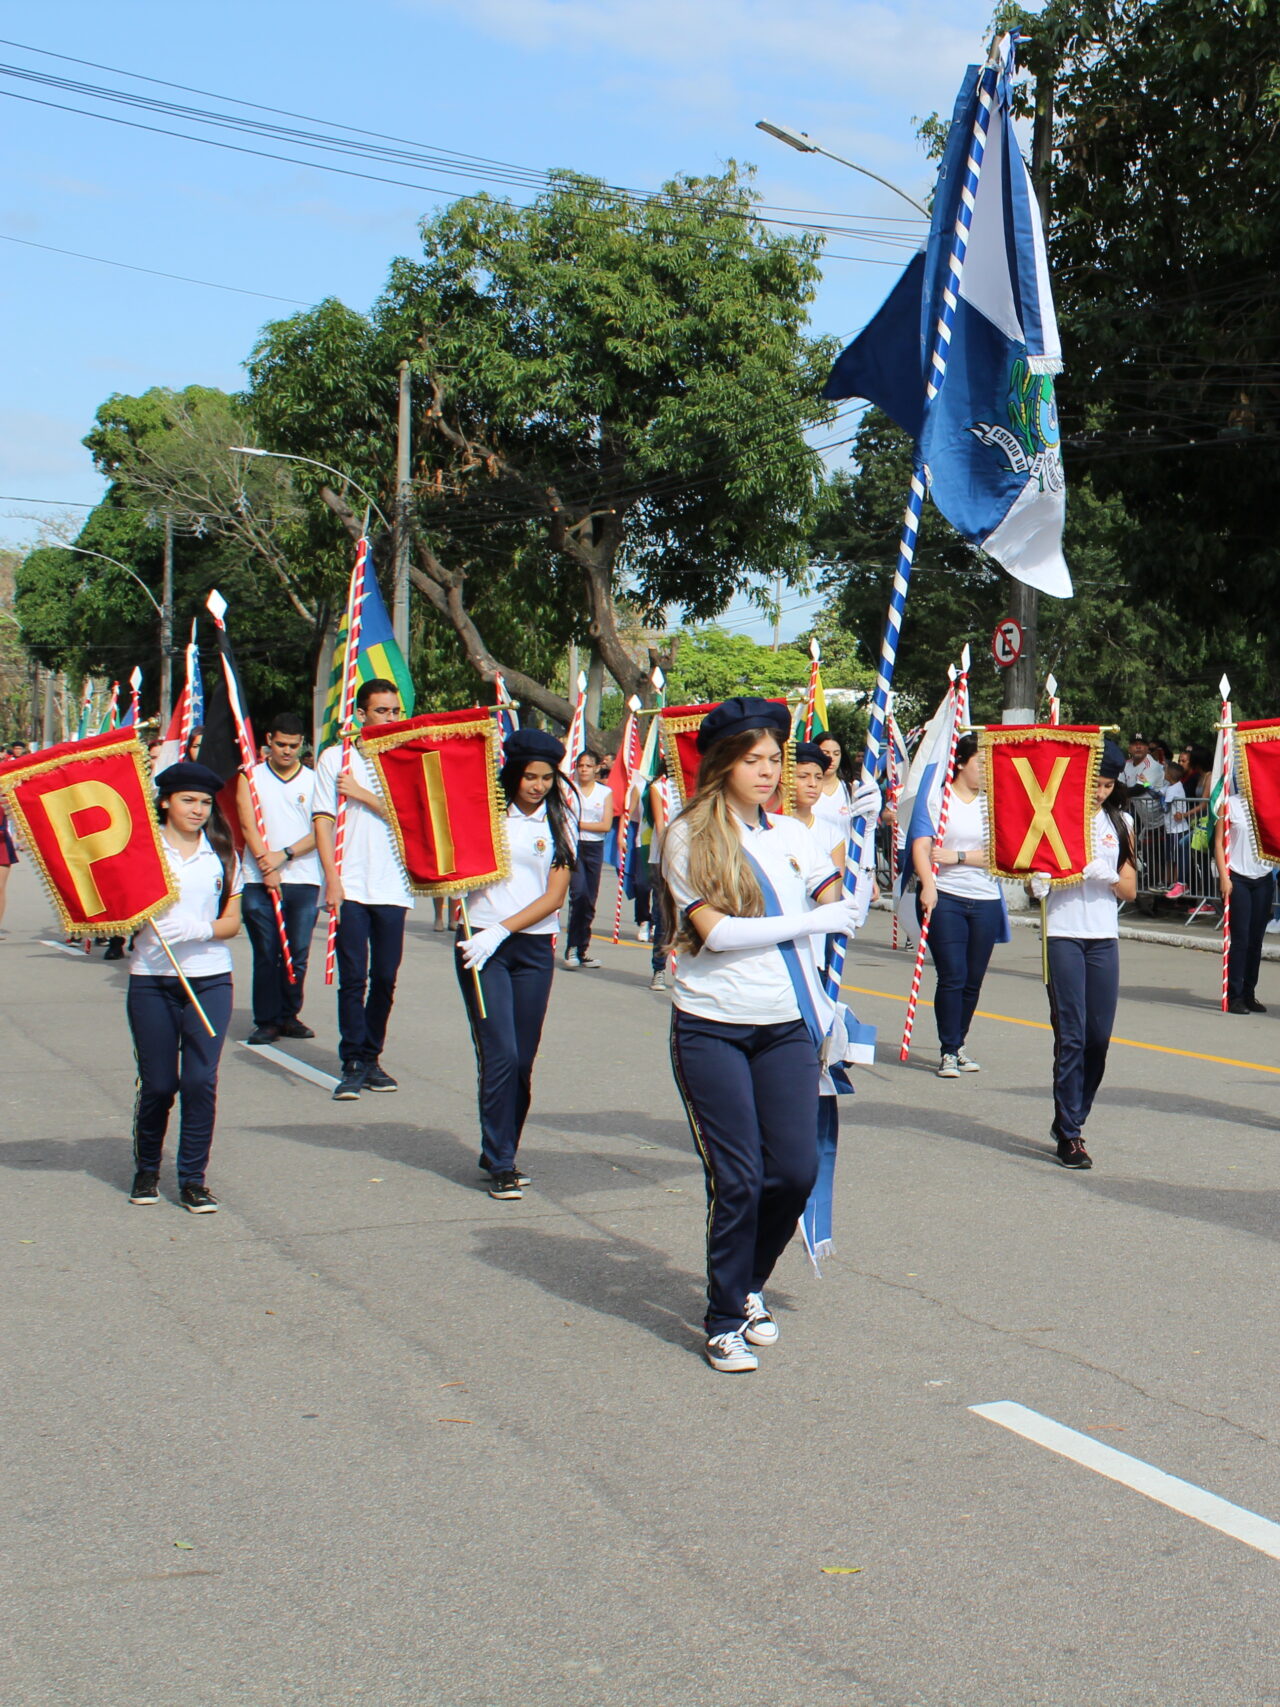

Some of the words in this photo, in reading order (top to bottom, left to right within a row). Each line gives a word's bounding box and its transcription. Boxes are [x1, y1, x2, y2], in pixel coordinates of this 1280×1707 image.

[993, 429, 1019, 457] ESTADO
[1015, 458, 1026, 471] DO
[1002, 628, 1014, 656] E
[40, 781, 131, 916] P
[1012, 758, 1072, 869] X
